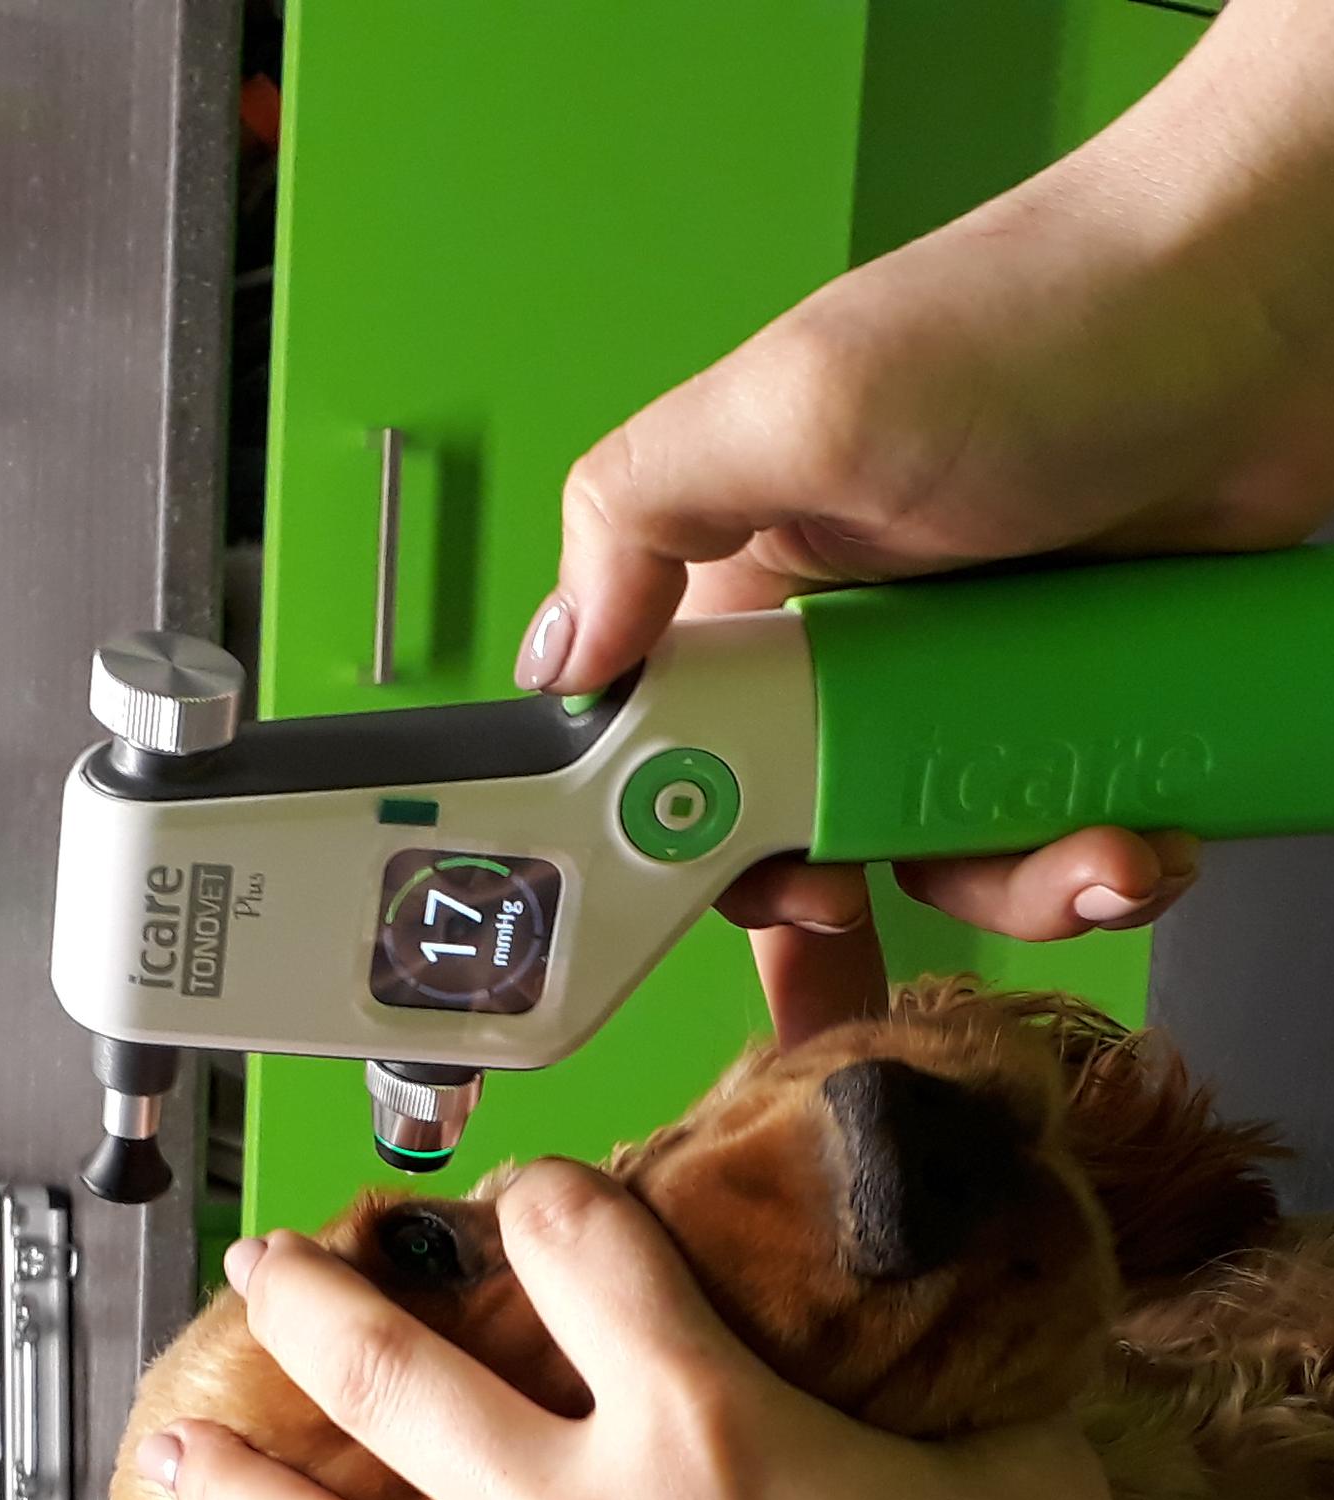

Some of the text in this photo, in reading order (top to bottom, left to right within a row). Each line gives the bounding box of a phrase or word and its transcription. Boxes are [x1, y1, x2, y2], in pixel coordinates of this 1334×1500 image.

[903, 726, 1213, 828] icare
[128, 865, 184, 990] icare
[189, 867, 226, 993] TONOVET
[232, 872, 265, 920] Plus
[420, 888, 483, 964] 17
[493, 900, 524, 966] mmHg
